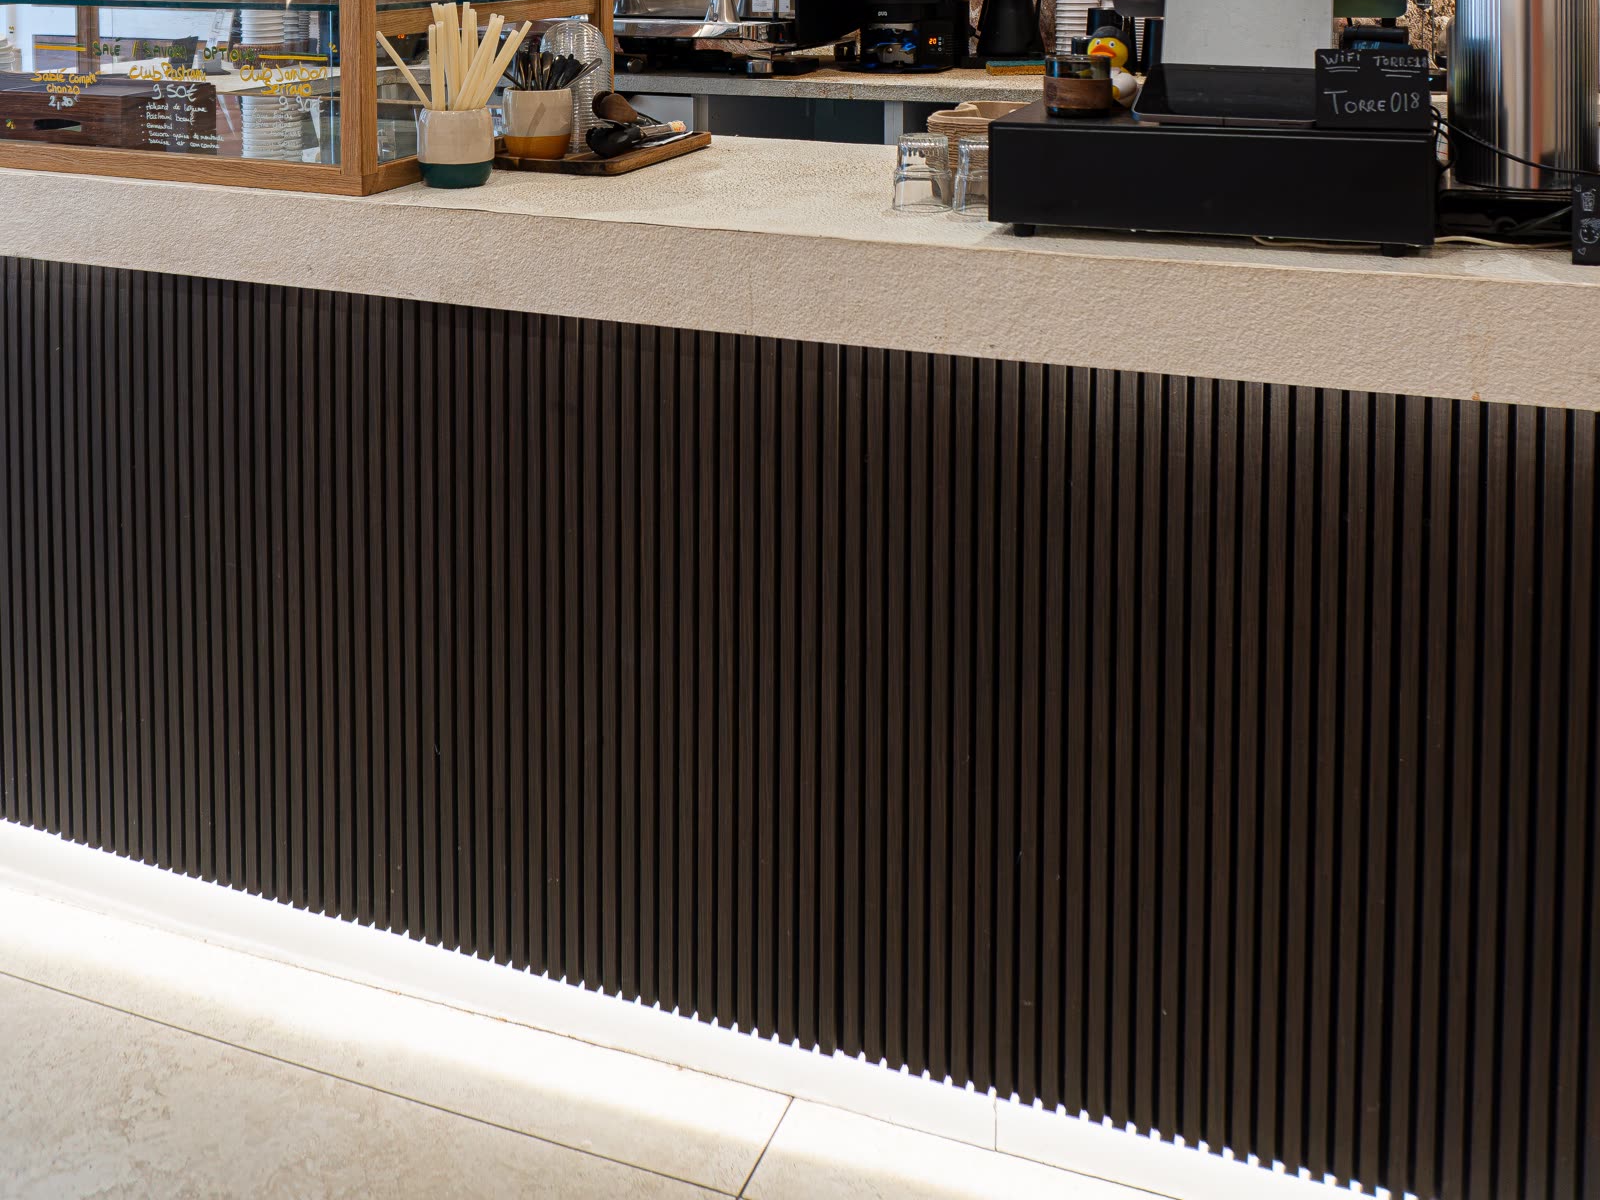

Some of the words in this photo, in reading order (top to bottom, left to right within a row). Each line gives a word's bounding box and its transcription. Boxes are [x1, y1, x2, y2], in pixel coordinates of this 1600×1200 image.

[928, 37, 937, 45] 20
[128, 64, 161, 83] Club
[161, 61, 207, 82] Pastrami
[240, 61, 273, 83] Club
[275, 61, 328, 83] Jambon
[261, 79, 313, 98] Serrano
[172, 103, 181, 111] de
